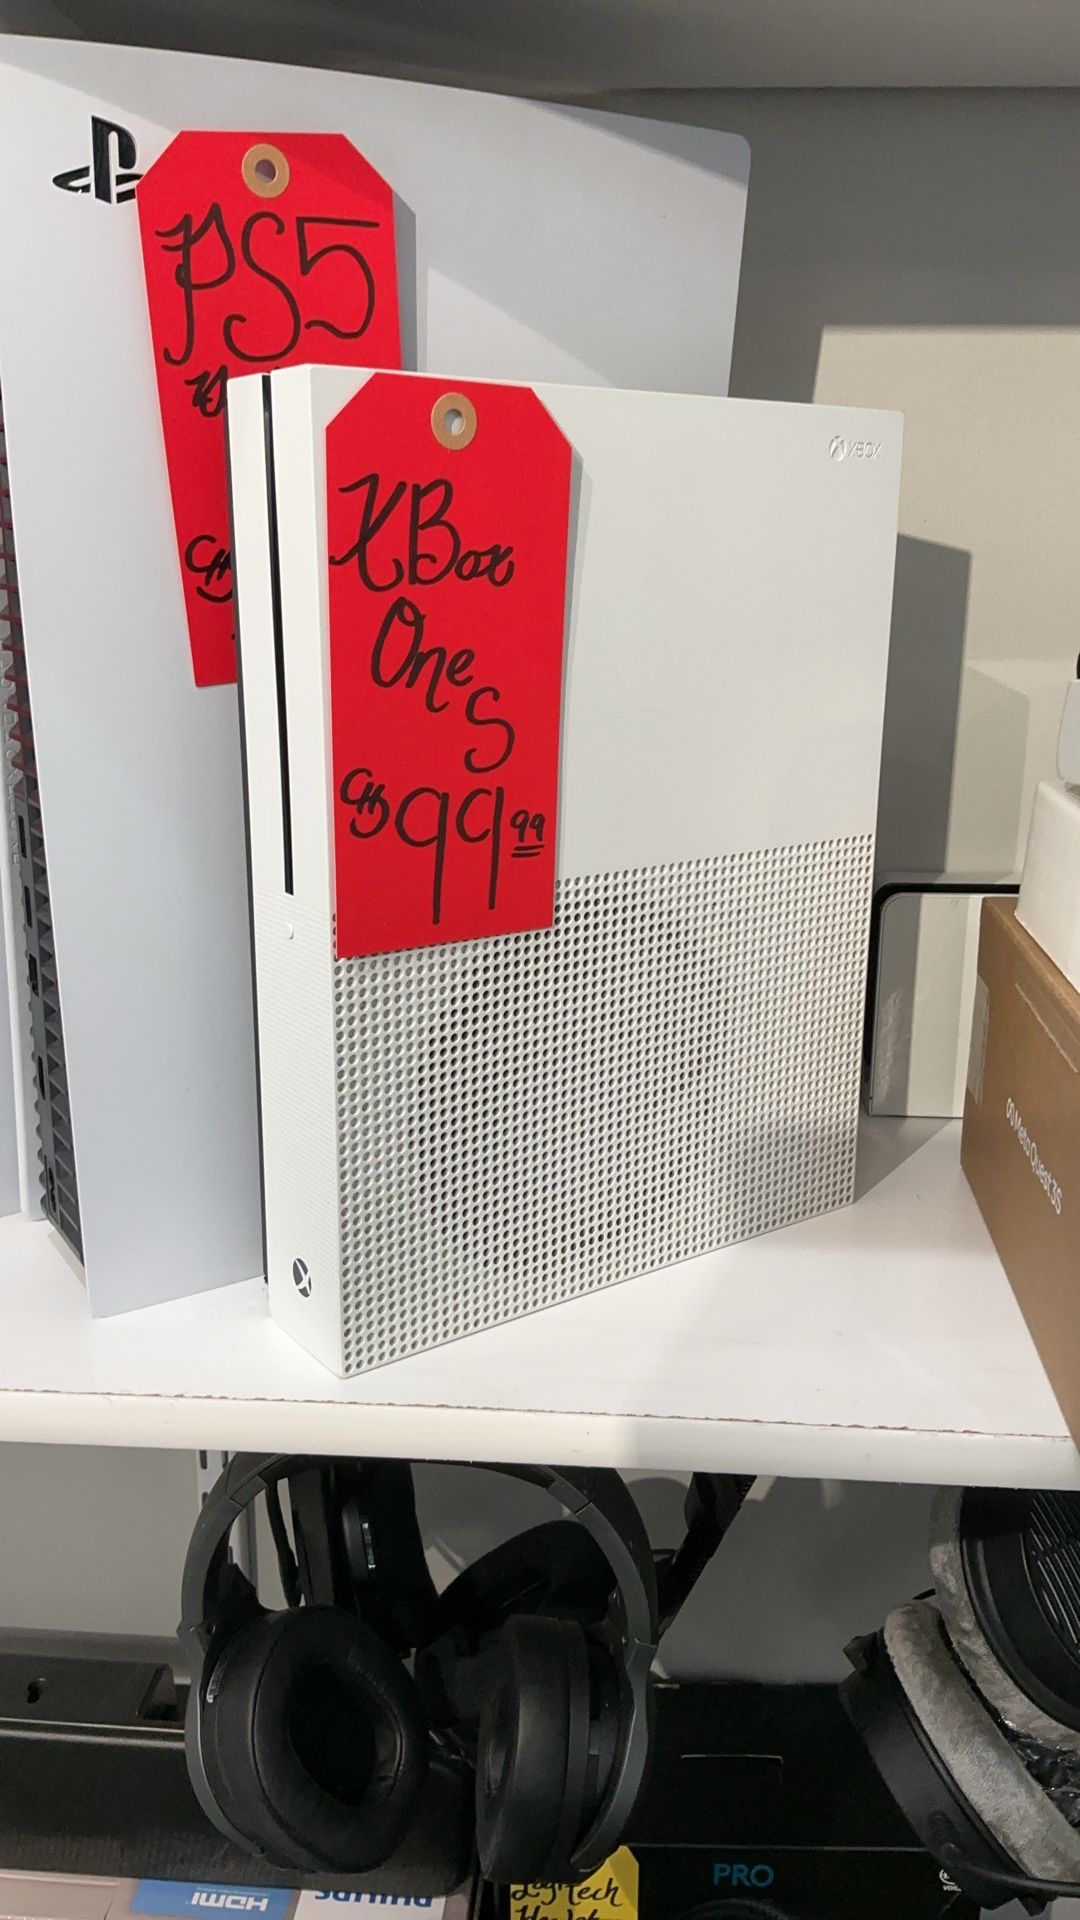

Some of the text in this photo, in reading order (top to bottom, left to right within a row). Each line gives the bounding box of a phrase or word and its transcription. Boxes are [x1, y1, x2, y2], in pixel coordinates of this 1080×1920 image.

[155, 202, 380, 365] PS5
[370, 596, 516, 774] One S
[1013, 1109, 1031, 1158] Meta
[1029, 1142, 1052, 1198] Quest
[190, 1891, 269, 1912] HDMI
[713, 1863, 775, 1888] PRO
